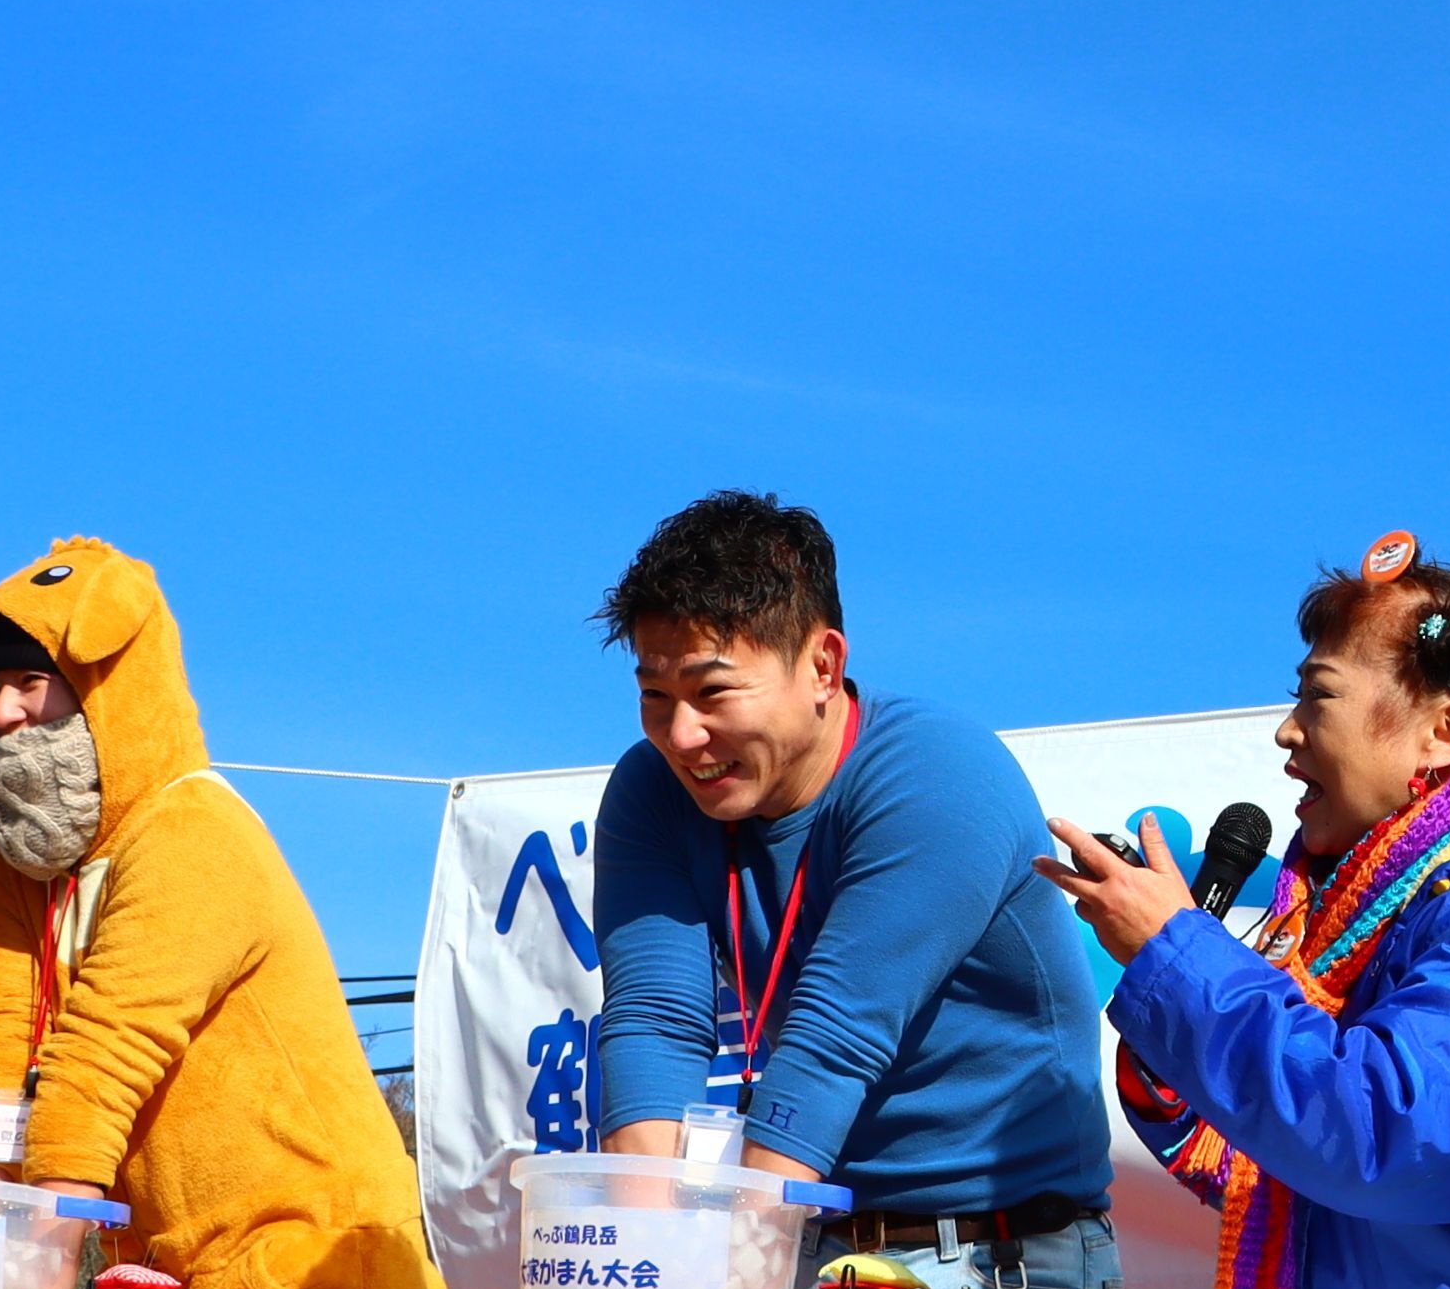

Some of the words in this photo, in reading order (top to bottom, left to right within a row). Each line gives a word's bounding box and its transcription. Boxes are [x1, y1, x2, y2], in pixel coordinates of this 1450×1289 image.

[766, 1100, 798, 1130] H
[533, 1224, 618, 1246] べっぷ鶴見岳
